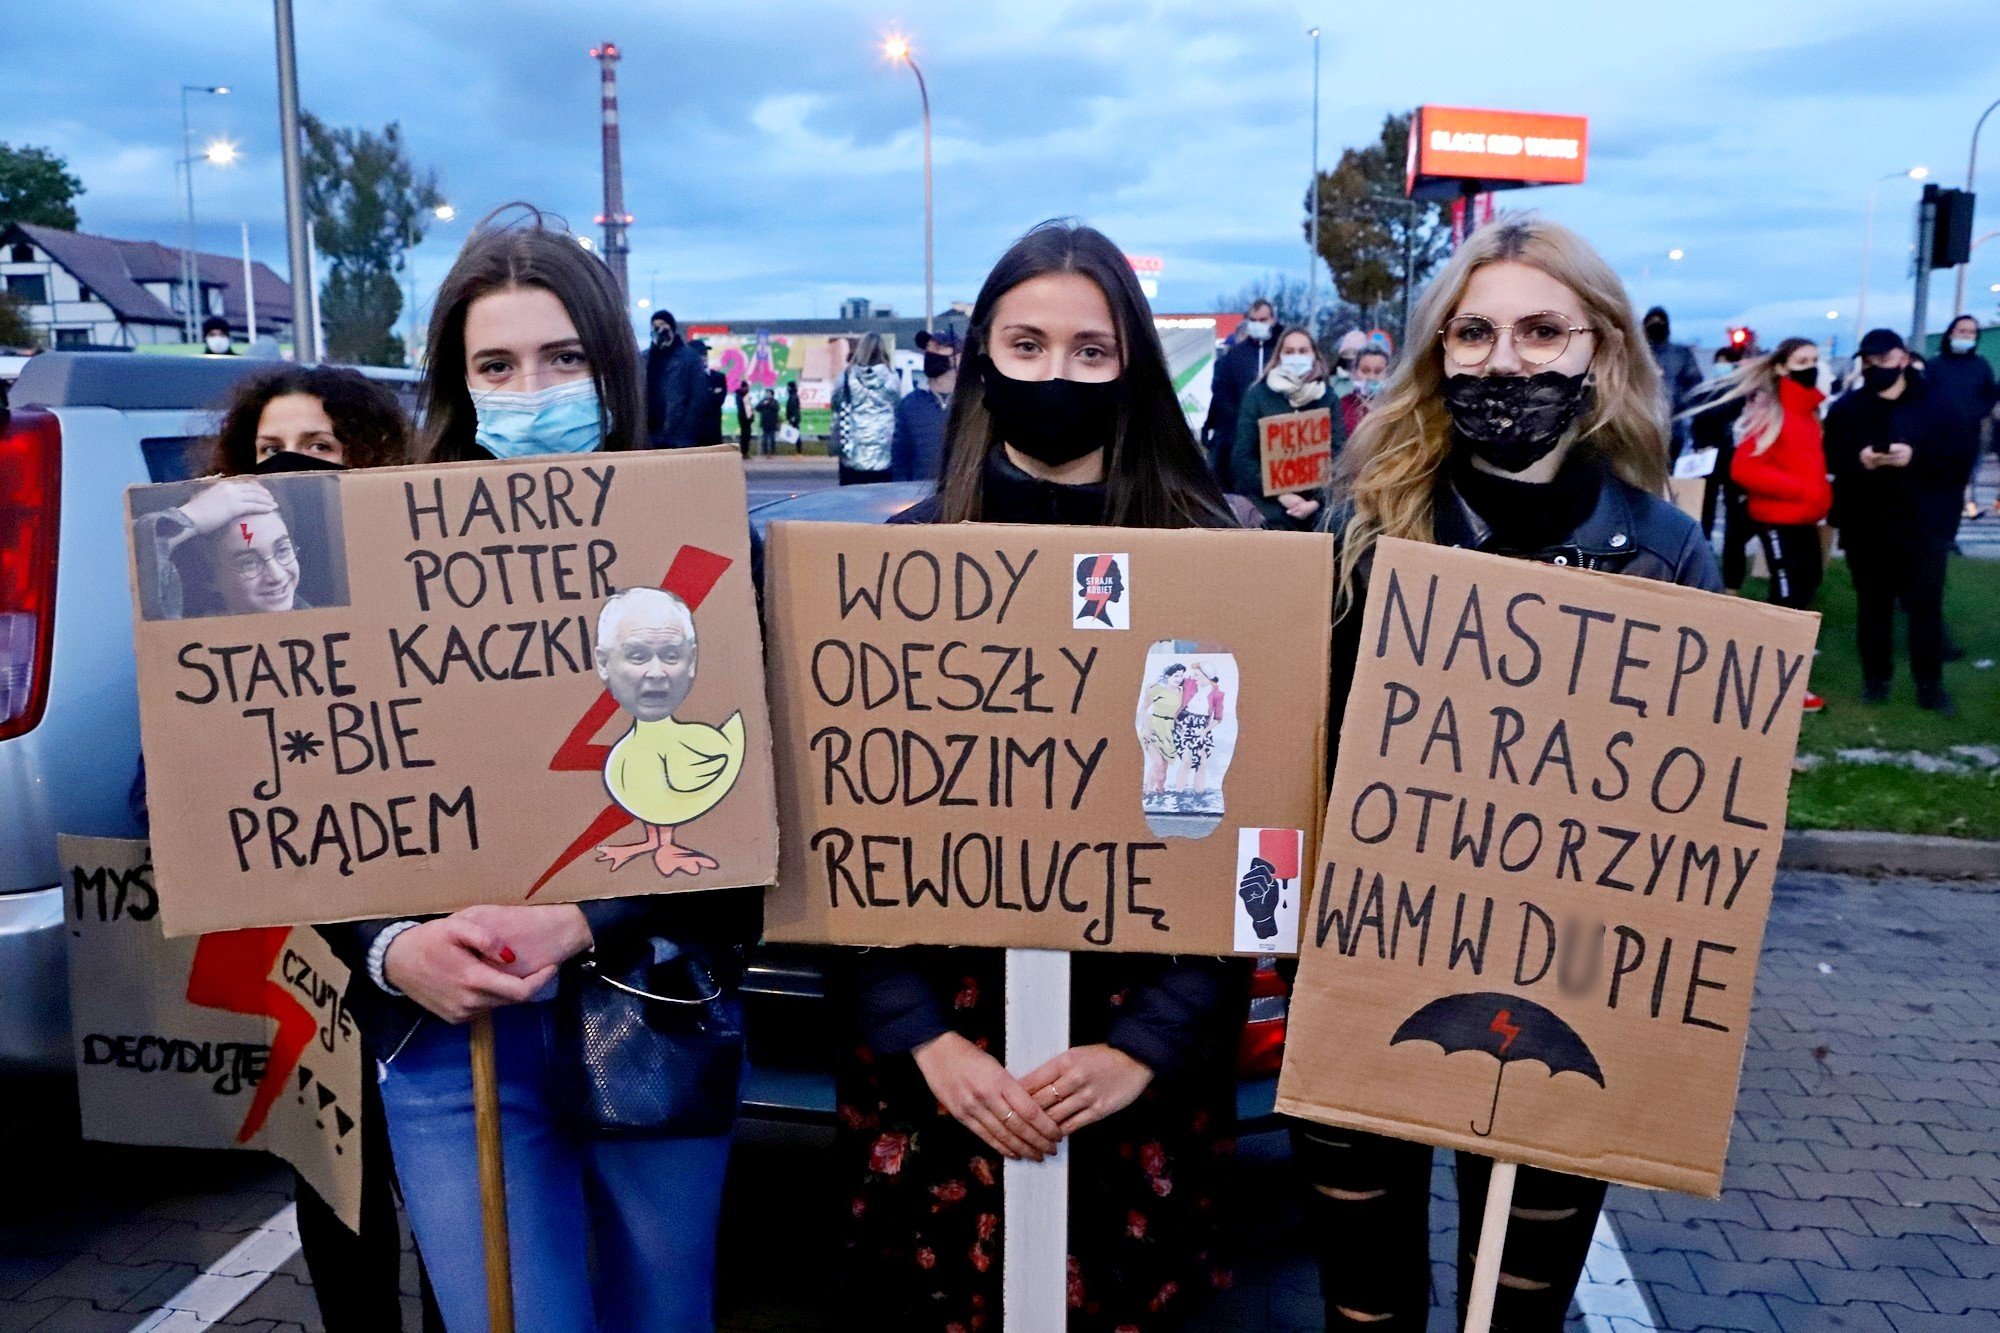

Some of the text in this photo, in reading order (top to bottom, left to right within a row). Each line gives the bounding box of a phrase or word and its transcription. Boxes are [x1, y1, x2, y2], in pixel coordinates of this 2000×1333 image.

[404, 465, 616, 540] HARRY
[404, 539, 617, 611] POTTER
[838, 549, 1038, 624] WODY
[1085, 576, 1114, 585] STRAJK
[1086, 585, 1113, 594] KOBIET
[175, 615, 596, 704] STARE KACZKI
[812, 639, 1098, 714] ODESZŁY
[1376, 567, 1804, 735] NASTĘPNY
[810, 726, 1108, 811] RODZIMY
[1380, 682, 1768, 831] PARASOL
[229, 786, 480, 876] PRĄDEM
[1351, 781, 1760, 909] OTWORZYMY
[72, 847, 160, 922] MYŚ
[810, 827, 1170, 946] REWOLUCJĘ
[1316, 862, 1437, 967] WAM
[1448, 892, 1494, 976] W
